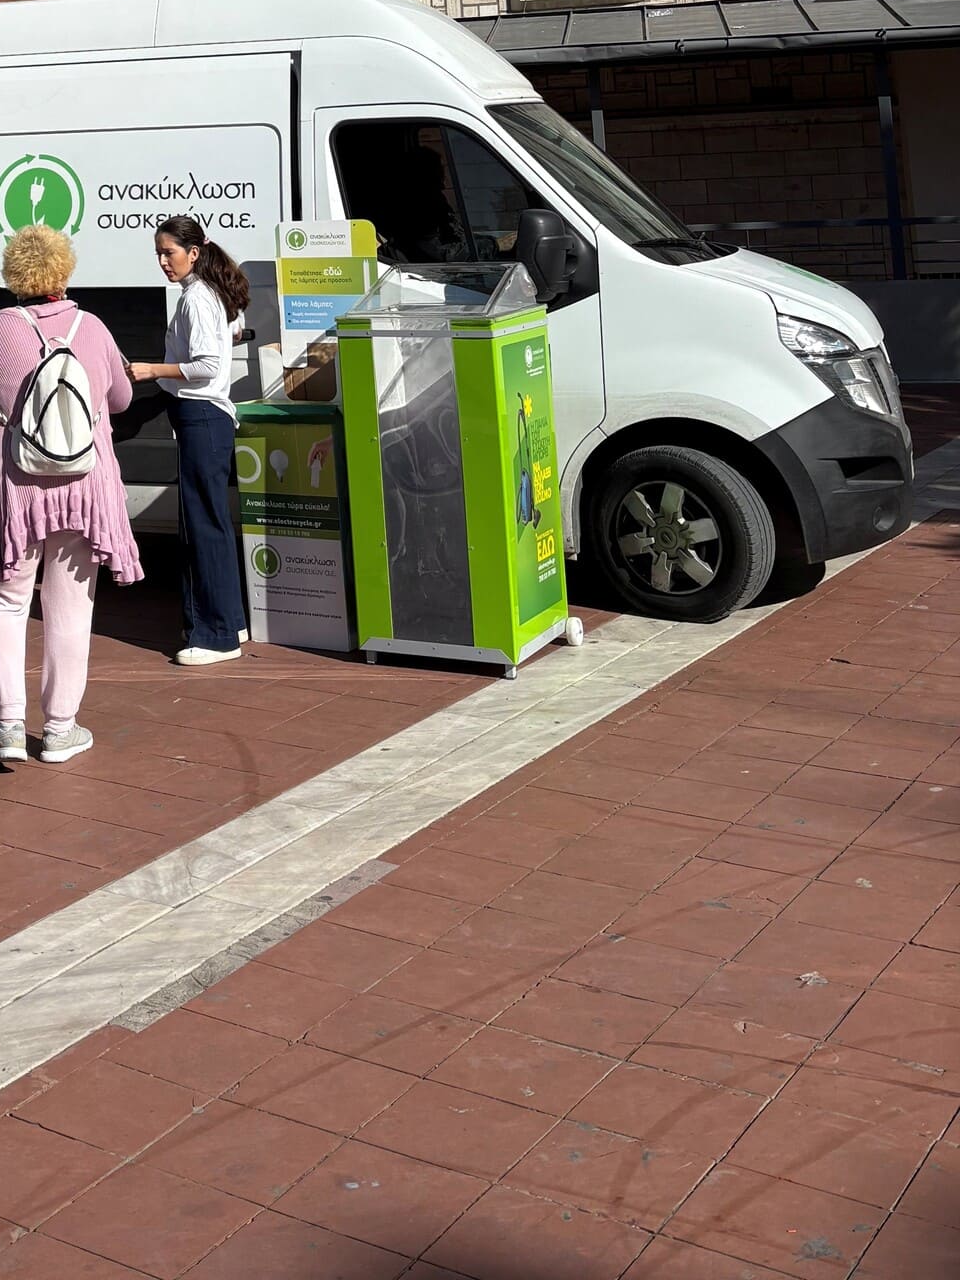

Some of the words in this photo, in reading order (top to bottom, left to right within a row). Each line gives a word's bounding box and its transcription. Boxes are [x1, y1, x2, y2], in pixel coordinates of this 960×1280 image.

[98, 171, 256, 201] ανακύκλωση
[97, 205, 214, 229] συσκεν
[218, 211, 256, 229] α.ε.
[323, 266, 343, 276] εδώ
[537, 535, 555, 562] ΕΔΩ
